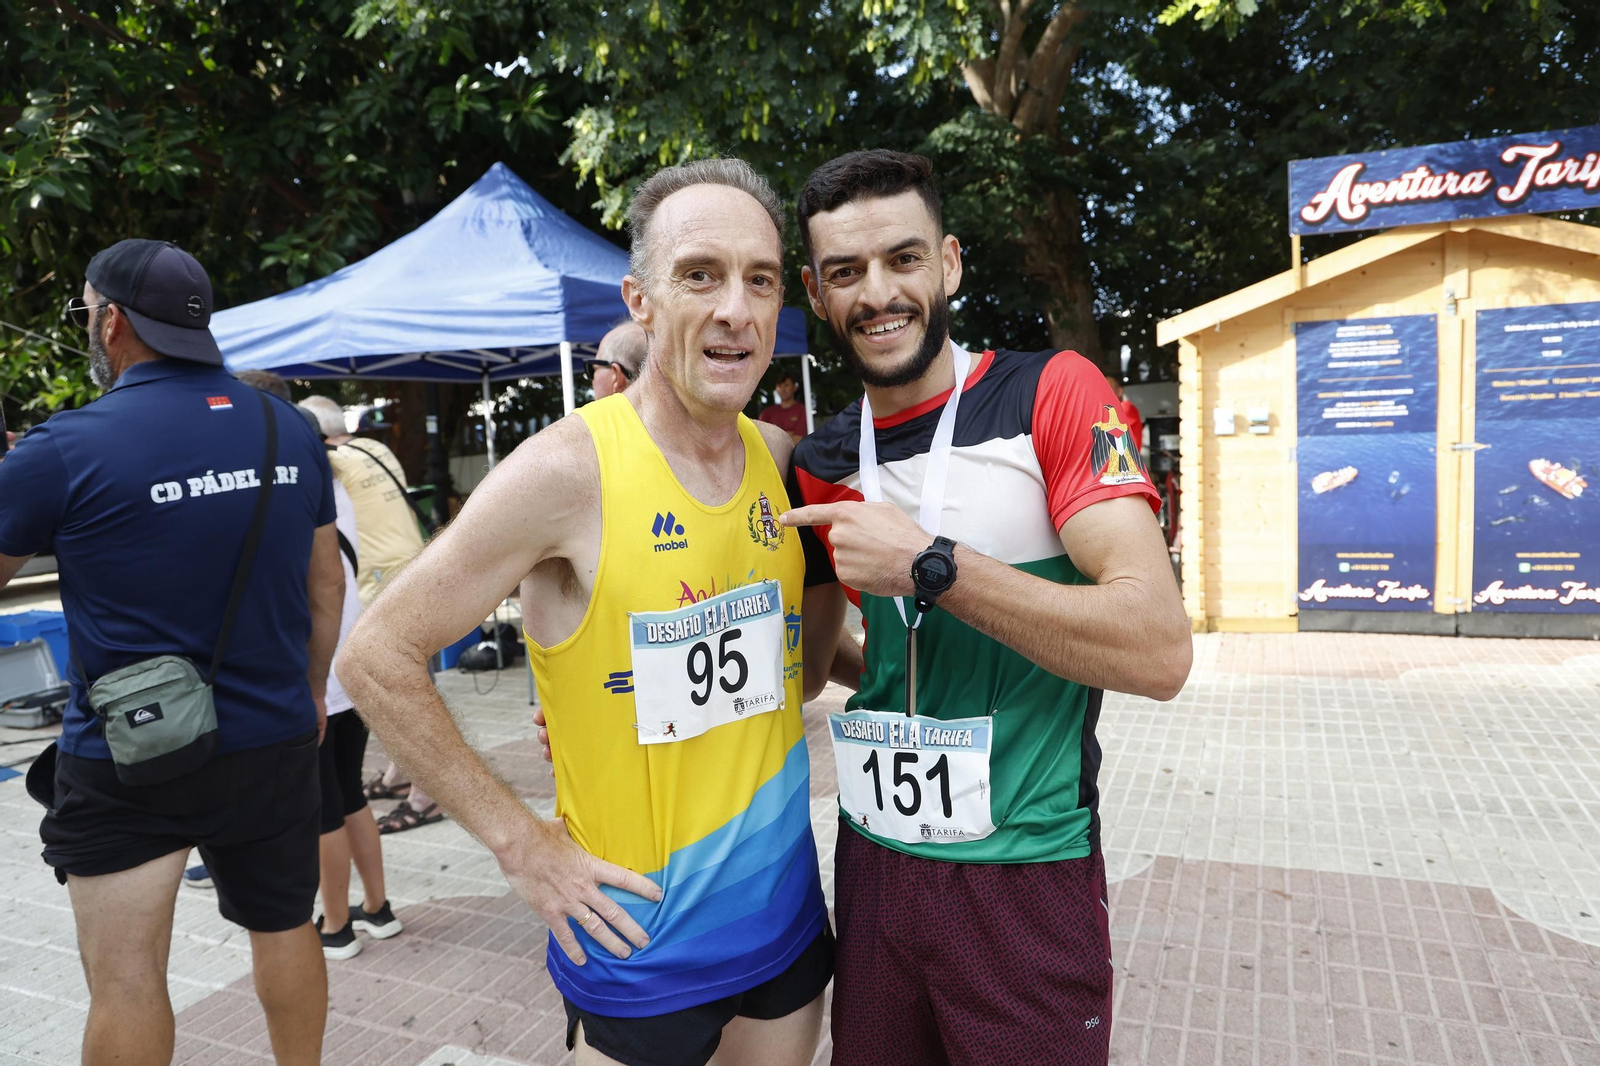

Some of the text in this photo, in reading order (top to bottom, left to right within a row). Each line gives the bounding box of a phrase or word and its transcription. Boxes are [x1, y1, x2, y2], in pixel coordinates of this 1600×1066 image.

[1301, 162, 1492, 222] Aventura
[150, 465, 299, 503] CD PÁDEL RF
[654, 538, 689, 553] mobel
[647, 593, 771, 643] DESAFÍO ELA TARIFA
[686, 628, 748, 706] 95
[745, 694, 776, 708] TARIFA
[840, 719, 973, 749] DESAFÍO ELA TARIFA
[862, 749, 952, 818] 151
